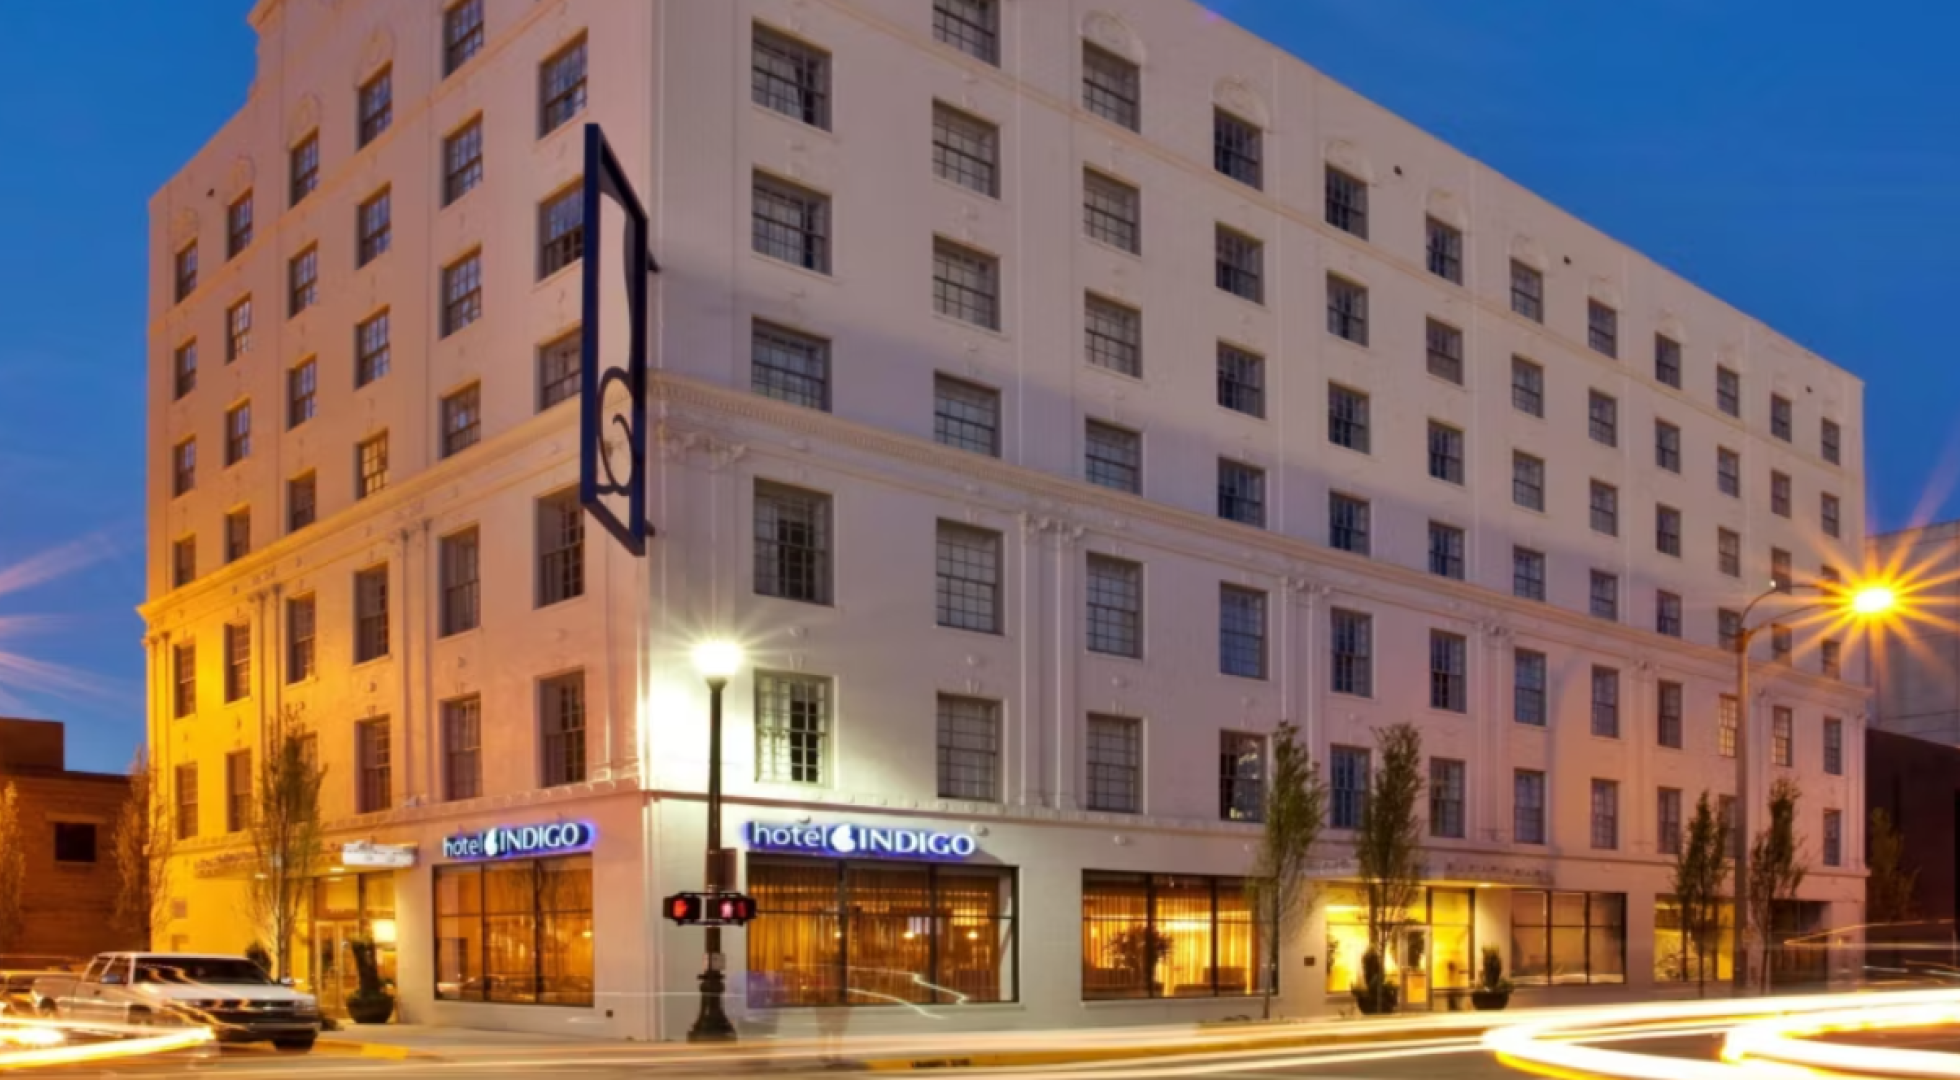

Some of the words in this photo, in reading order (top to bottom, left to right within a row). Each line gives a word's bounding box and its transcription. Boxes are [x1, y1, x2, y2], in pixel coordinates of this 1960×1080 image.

[443, 833, 483, 857] hotel
[500, 822, 580, 851] INDIGO
[754, 822, 827, 847] hotel
[859, 828, 975, 855] INDIGO
